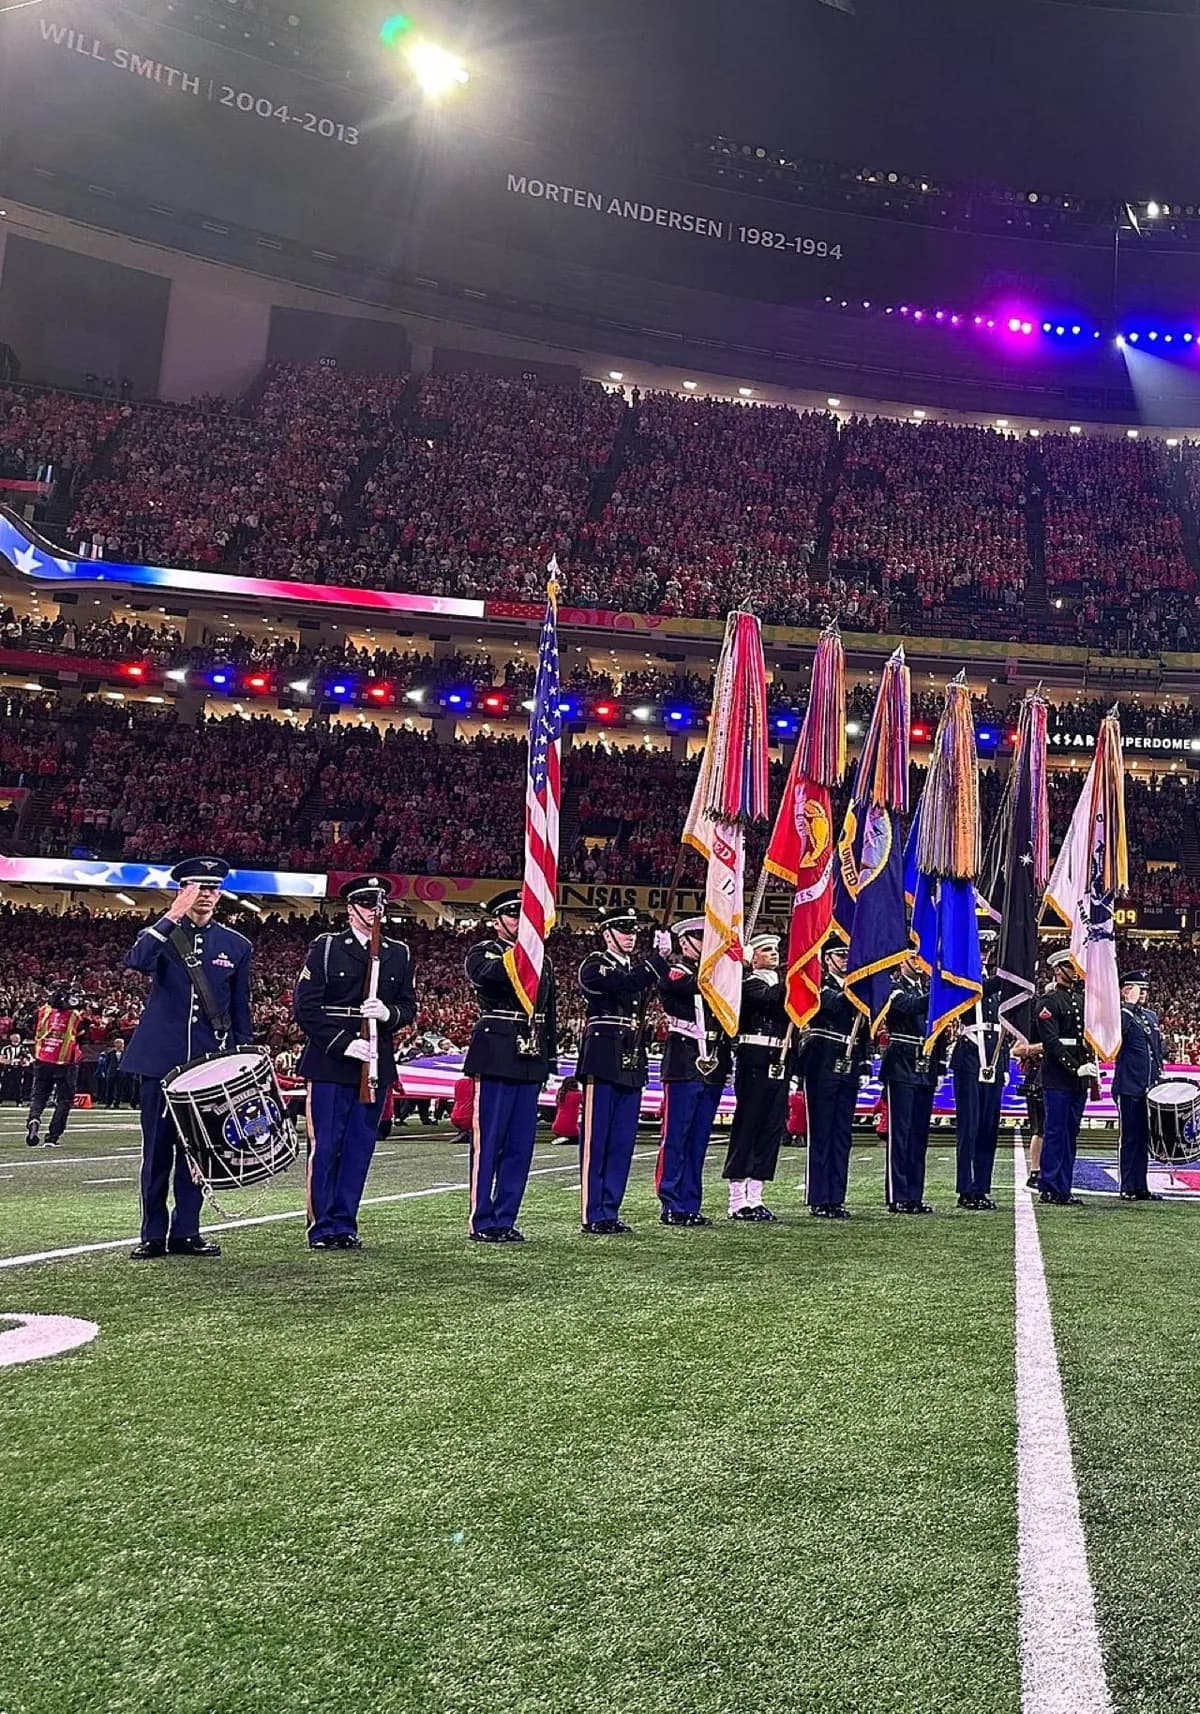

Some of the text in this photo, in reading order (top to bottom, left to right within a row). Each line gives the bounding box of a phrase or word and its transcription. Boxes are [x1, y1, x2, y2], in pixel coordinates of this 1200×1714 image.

[39, 18, 360, 146] WILL SMITH 2004-2013
[507, 173, 843, 260] MORTEN ANDERSEN 1982-1994
[1046, 733, 1191, 750] ESAR PERDOME
[842, 847, 857, 886] UNITED
[556, 886, 637, 906] NSAS
